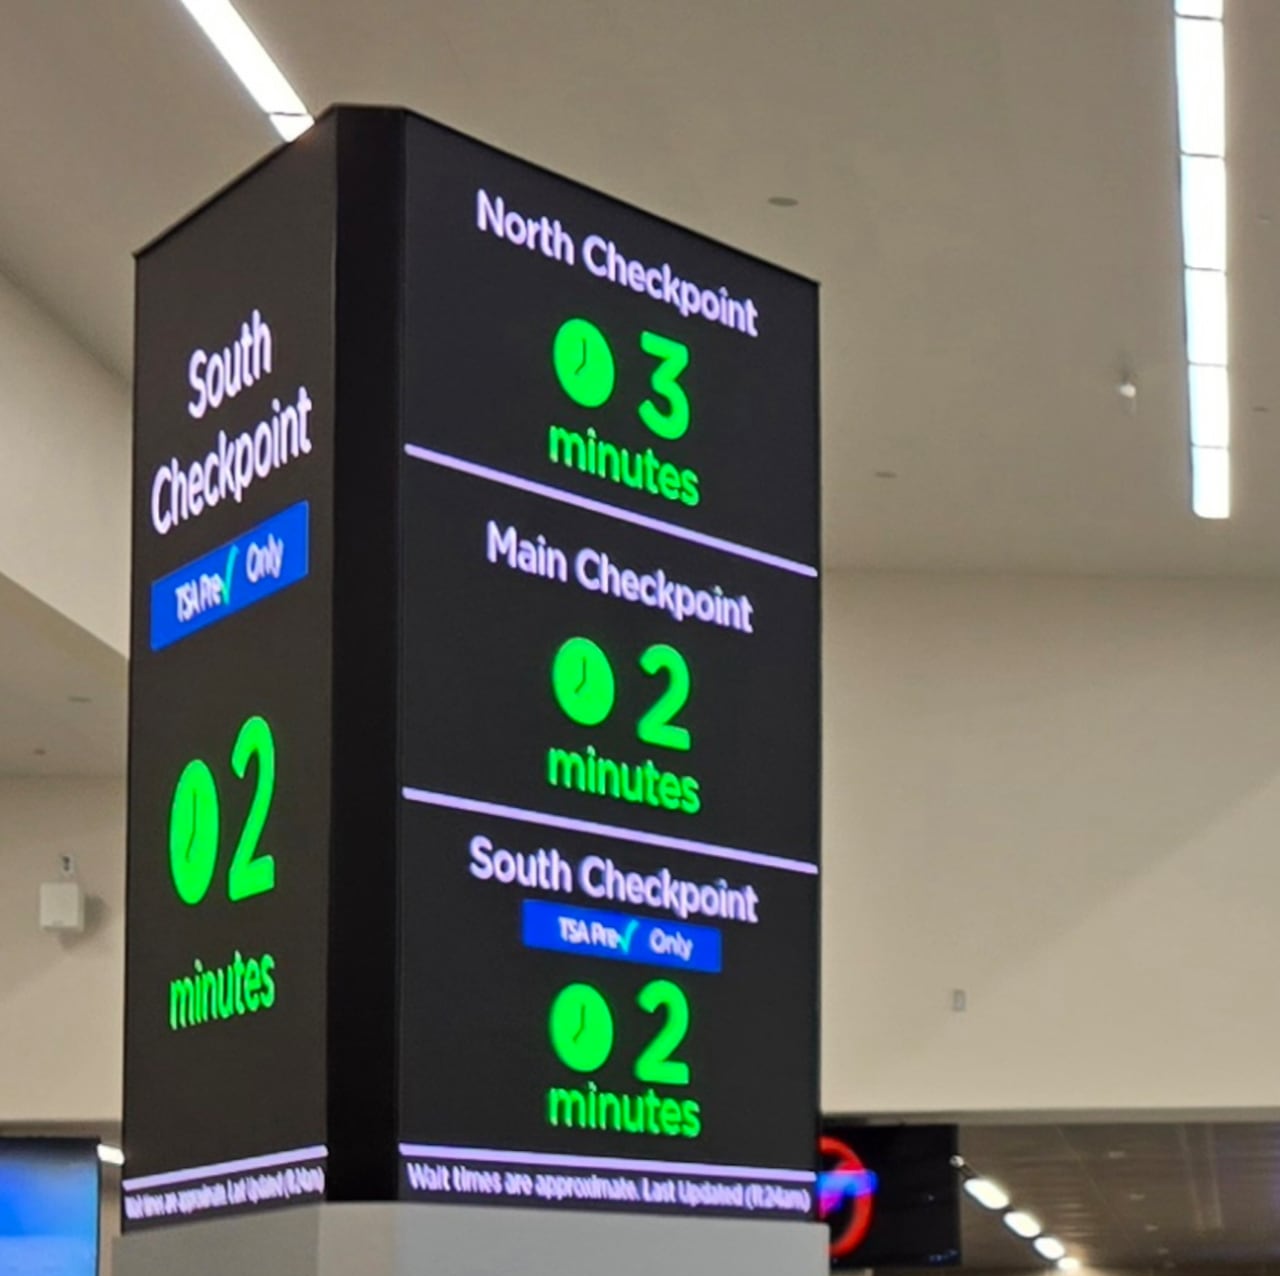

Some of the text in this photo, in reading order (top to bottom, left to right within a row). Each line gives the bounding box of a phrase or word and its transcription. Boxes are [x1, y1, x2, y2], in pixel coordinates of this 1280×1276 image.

[477, 188, 758, 337] North Checkpoint
[188, 309, 272, 419] South
[638, 330, 690, 440] 3
[152, 386, 312, 535] Checkpoint
[549, 424, 700, 506] minutes
[245, 533, 284, 583] Only
[487, 519, 754, 633] Main Checkpoint
[637, 643, 691, 751] 2
[228, 714, 276, 901] 2
[549, 744, 701, 815] minutes
[469, 834, 759, 924] South Checkpoint
[557, 915, 590, 945] TSA
[649, 927, 694, 961] Only
[168, 950, 276, 1030] minutes
[635, 978, 690, 1086] 2
[549, 1080, 701, 1138] minutes
[406, 1162, 451, 1191] Wait
[452, 1165, 502, 1194] times
[504, 1171, 533, 1196] are
[642, 1176, 676, 1203] Last
[677, 1179, 744, 1208] Updated
